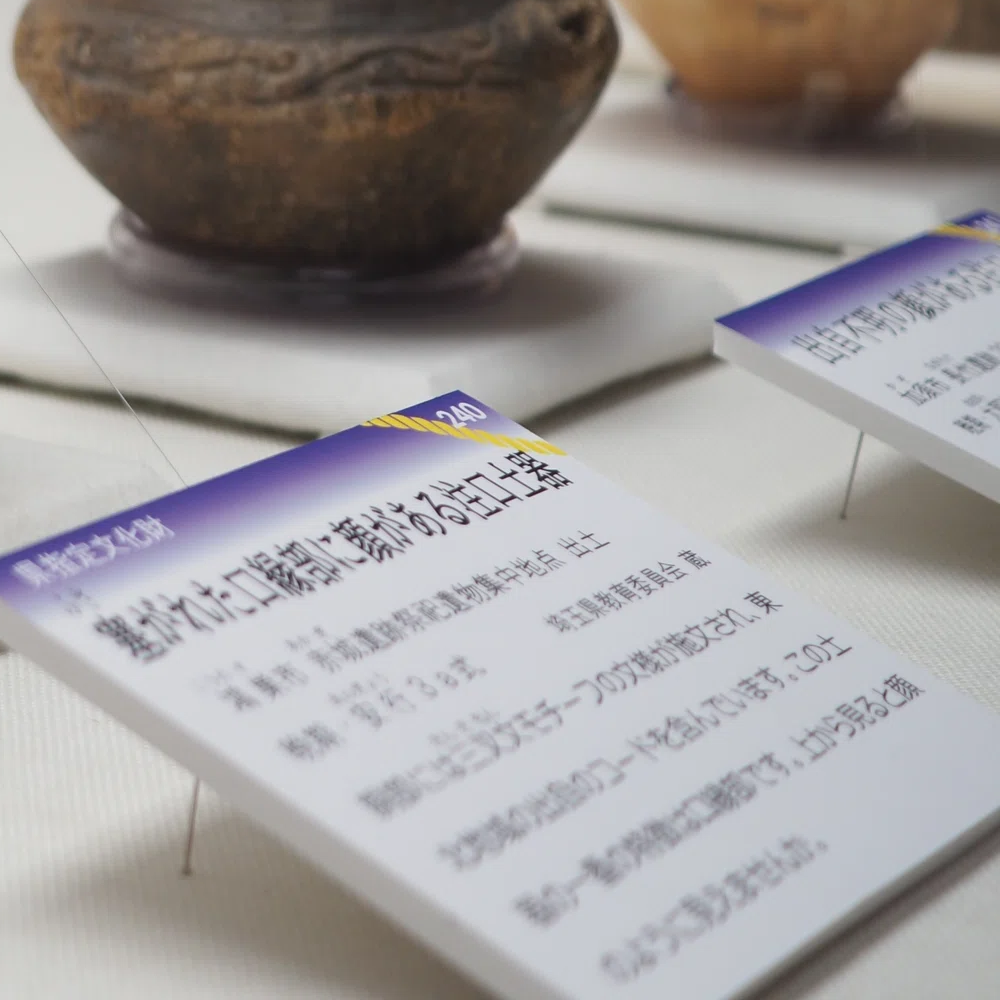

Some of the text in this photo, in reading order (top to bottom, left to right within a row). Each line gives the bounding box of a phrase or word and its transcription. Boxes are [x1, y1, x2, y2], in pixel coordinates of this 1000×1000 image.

[432, 400, 491, 430] 240
[5, 514, 177, 589] 県指定文化財
[83, 446, 577, 665] 塞がれた口縁部に顔がある注口土器
[554, 527, 613, 559] 出土
[540, 546, 713, 634] 埼玉県教育委員会 蔵
